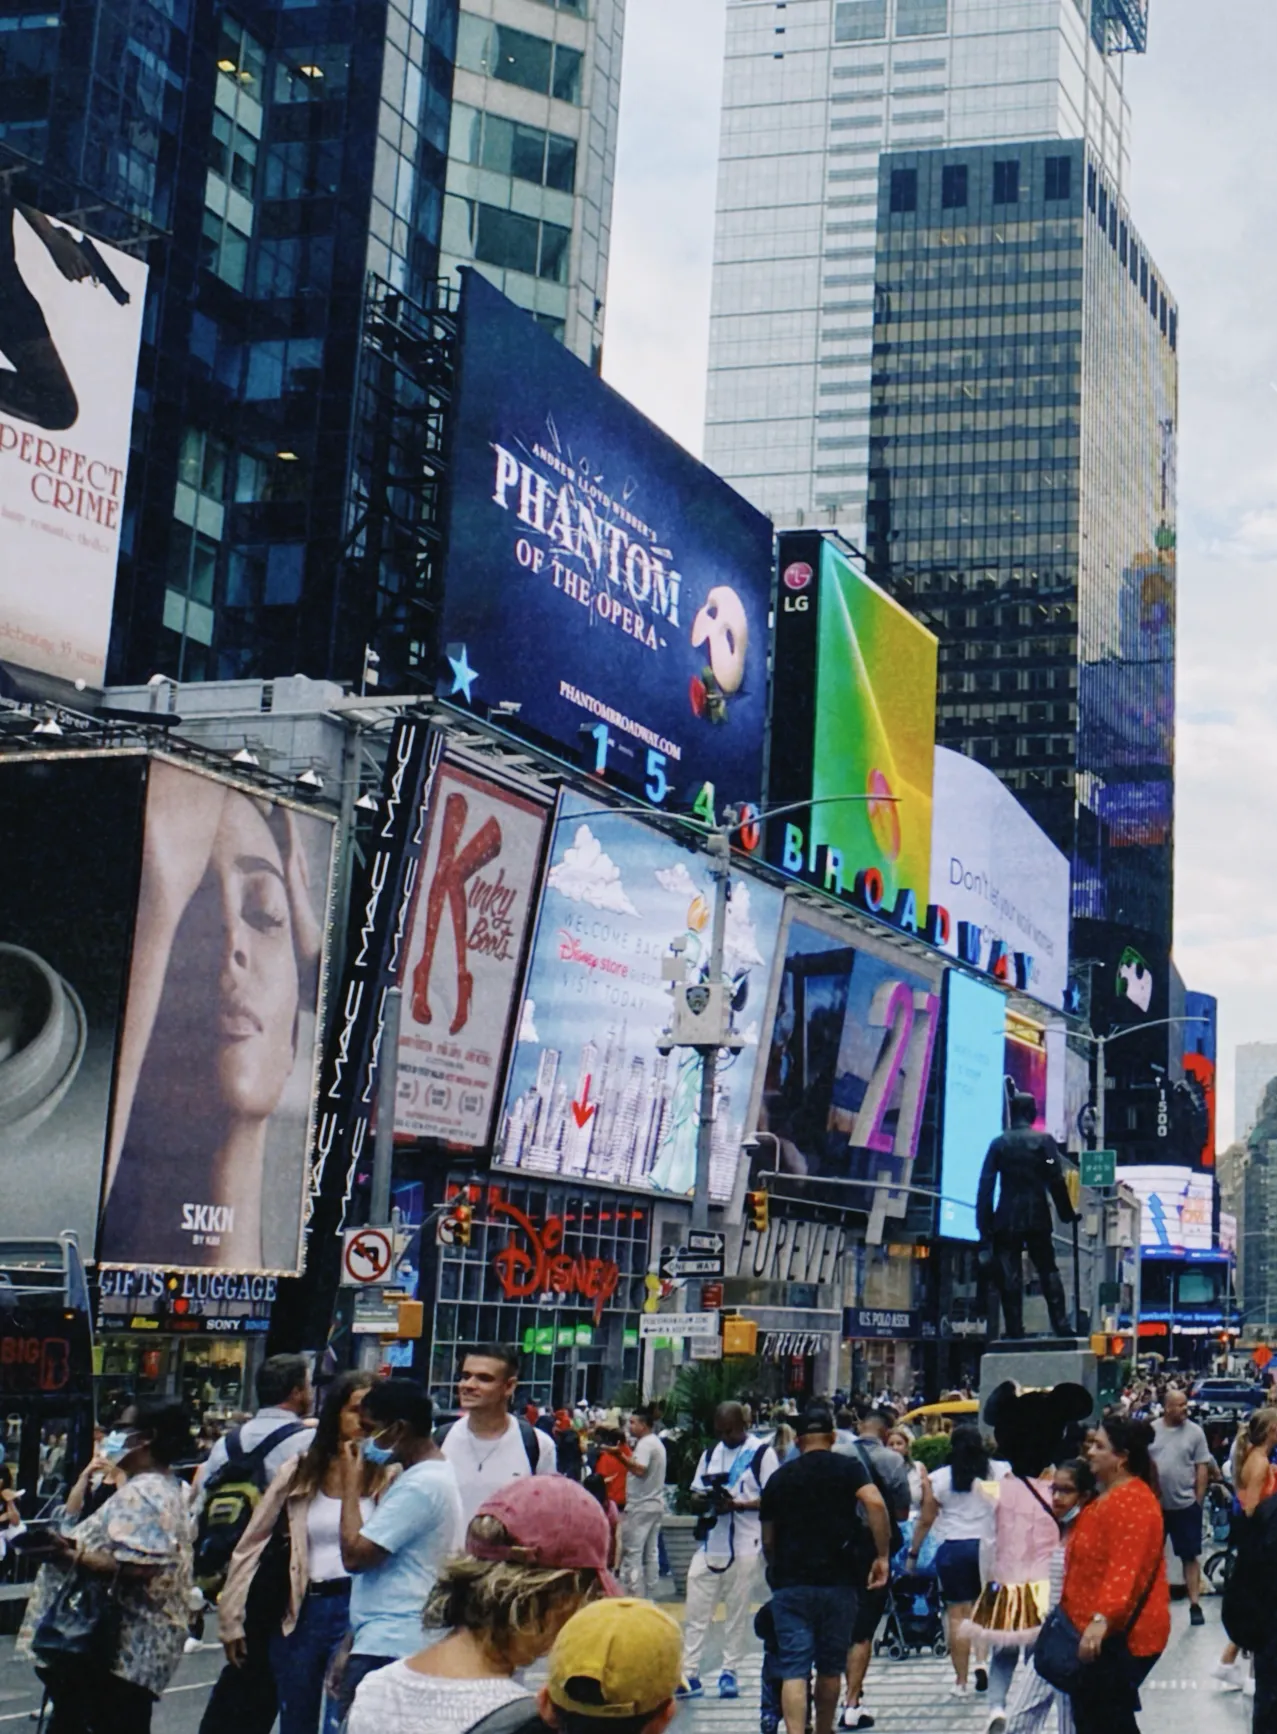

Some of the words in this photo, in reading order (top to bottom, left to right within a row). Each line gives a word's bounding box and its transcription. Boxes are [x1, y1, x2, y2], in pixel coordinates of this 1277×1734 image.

[0, 423, 124, 497] PERFECT
[532, 443, 575, 481] ANDREW
[578, 476, 610, 507] LLOYD
[31, 472, 119, 530] CRIME
[492, 443, 681, 628] PHANTOM
[516, 539, 545, 574] OF
[552, 560, 591, 606] THE
[597, 592, 658, 650] OPERA
[784, 596, 808, 612] LG
[560, 680, 682, 760] PHANTOMBROADWAY.COM
[950, 858, 988, 896] Don't
[783, 823, 1034, 990] BROADWAY
[468, 916, 514, 961] Boots
[556, 929, 598, 976] Disney
[600, 957, 629, 978] store
[564, 913, 629, 950] WELCOME
[605, 984, 645, 1009] TODAY
[849, 980, 940, 1159] 21
[181, 1203, 234, 1232] SKKN
[98, 1271, 165, 1297] GIFTS
[181, 1273, 278, 1301] LUGGAGE
[494, 1200, 619, 1327] Disney
[696, 1261, 717, 1272] WAY
[206, 1319, 241, 1330] SONY
[1, 1337, 40, 1364] BIG
